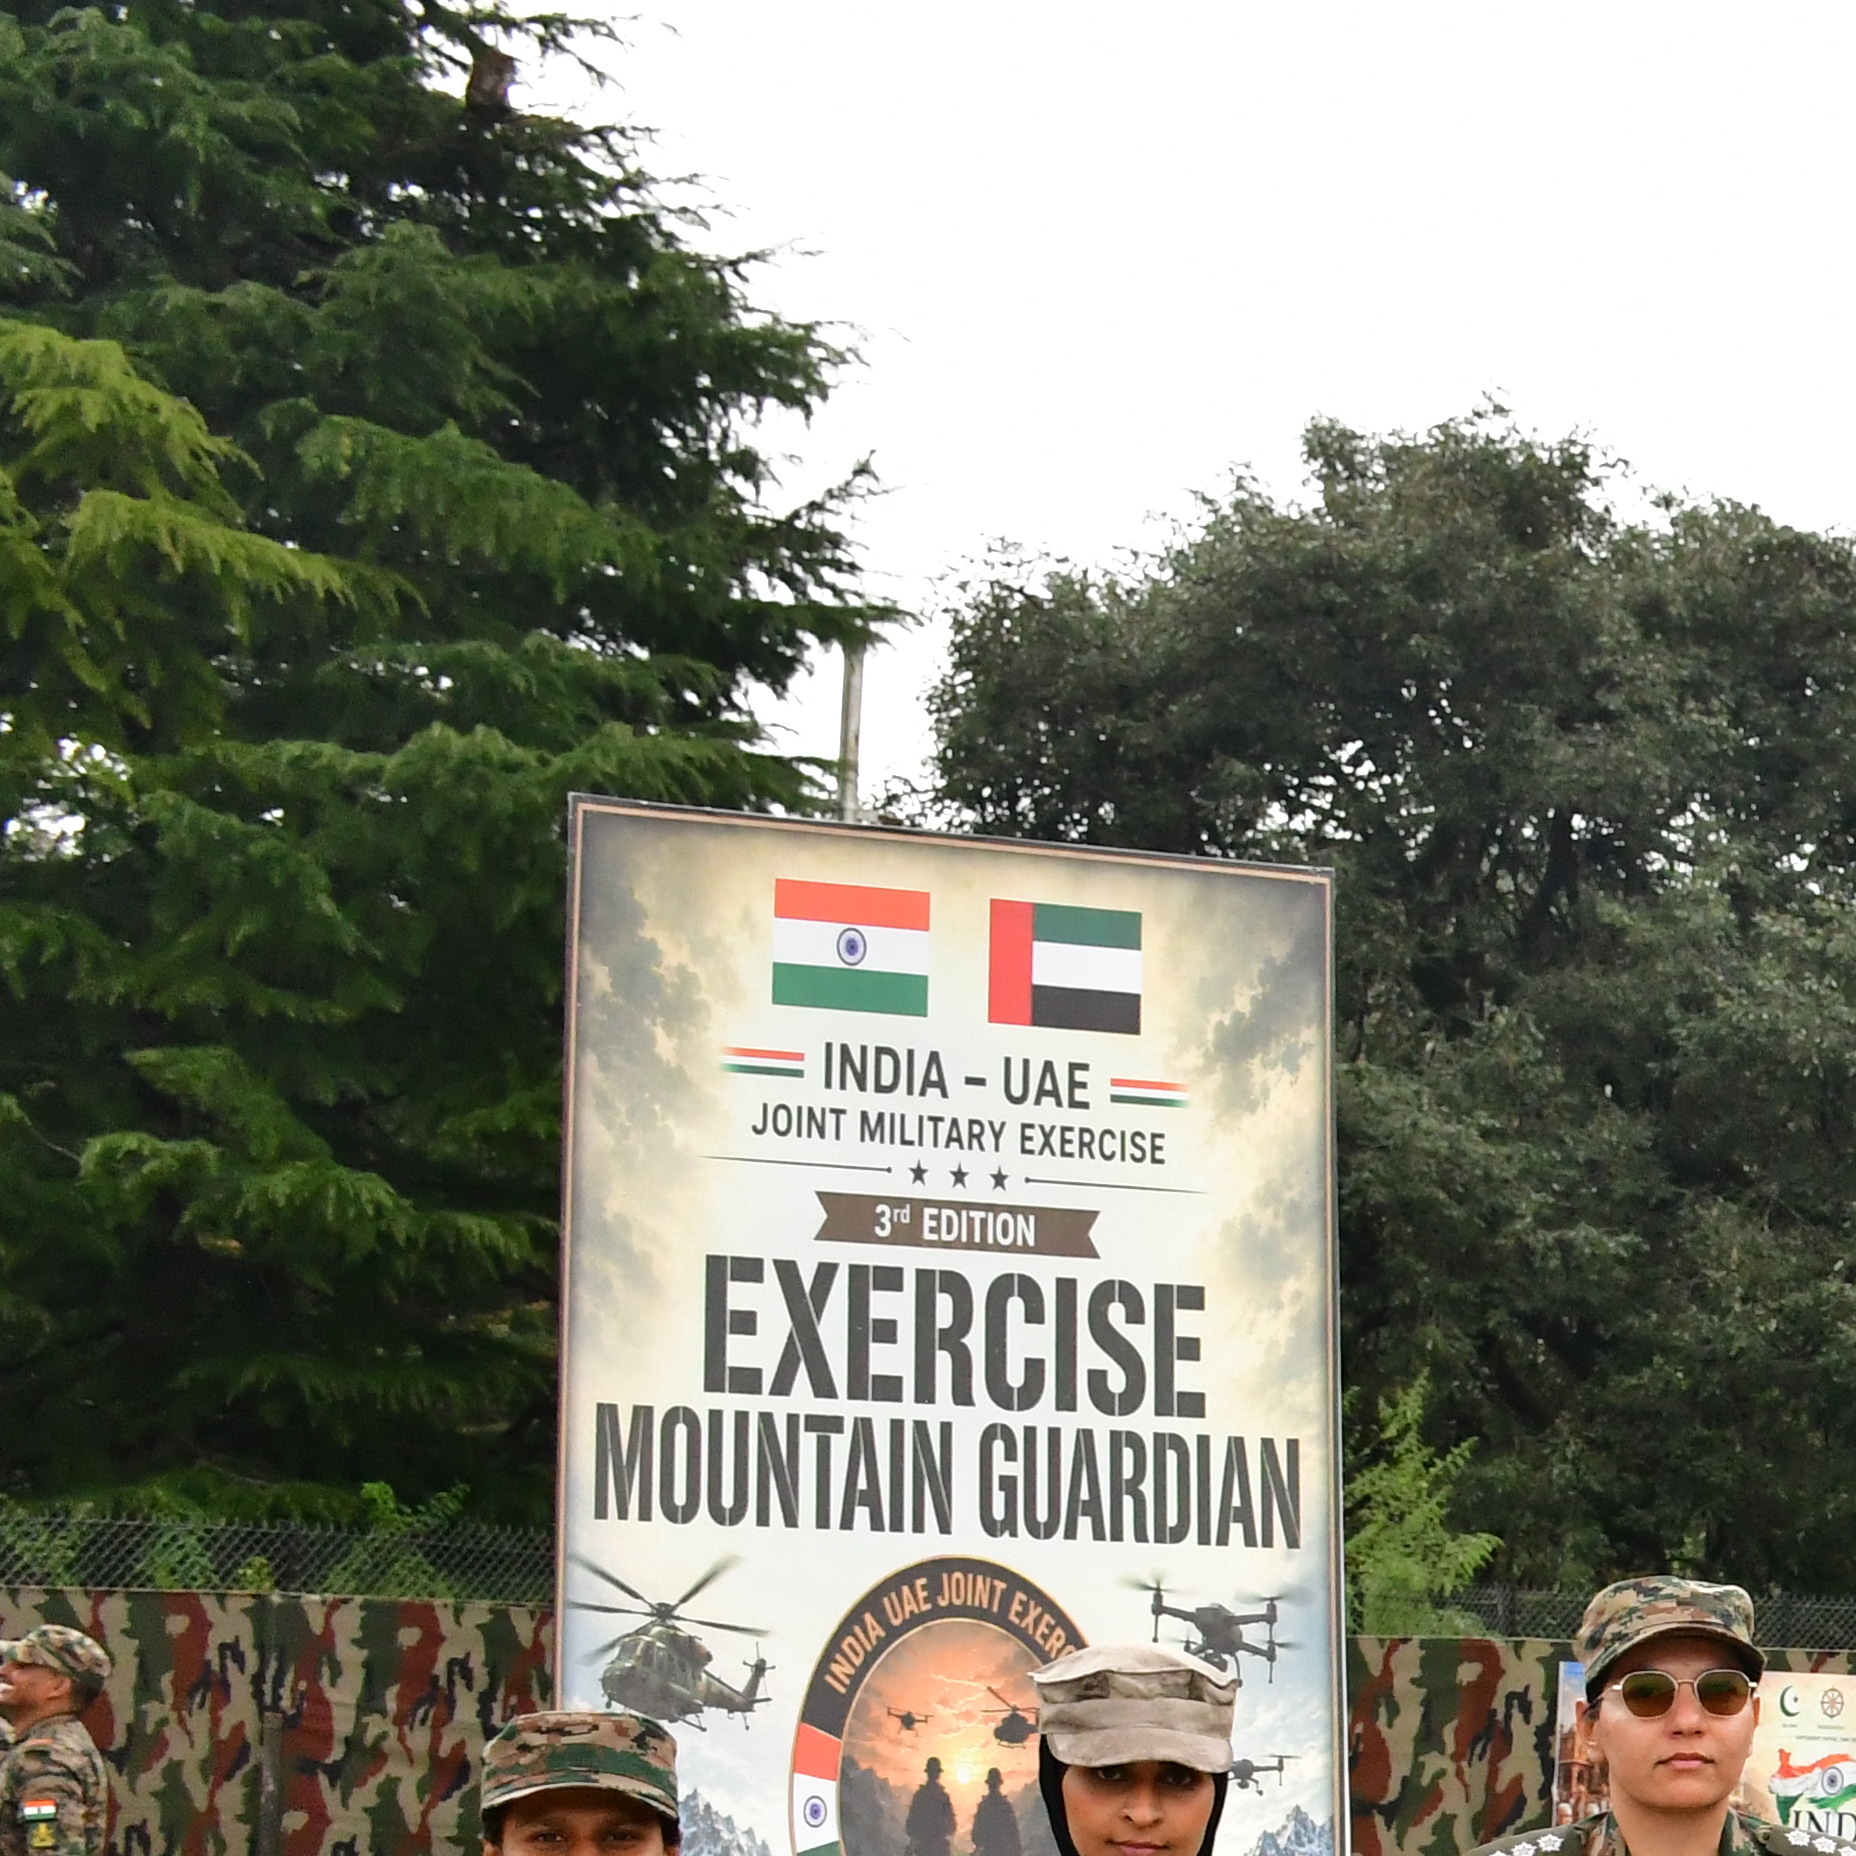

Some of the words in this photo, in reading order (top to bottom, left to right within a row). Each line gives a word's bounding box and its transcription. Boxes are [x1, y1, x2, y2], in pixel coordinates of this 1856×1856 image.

[824, 1041, 949, 1099] INDIA
[1003, 1056, 1091, 1110] UAE
[751, 1103, 847, 1141] JOINT
[859, 1111, 1006, 1154] MILITARY
[1020, 1123, 1166, 1166] EXERCISE
[874, 1203, 911, 1239] 3rd
[923, 1207, 1036, 1247] EDITION
[703, 1254, 1206, 1418] EXERCISE
[594, 1402, 953, 1535] MOUNTAIN
[978, 1422, 1302, 1550] GUARDIAN
[824, 1611, 887, 1695] INDIA
[882, 1577, 932, 1627] UAE
[937, 1571, 1008, 1614] JOINT
